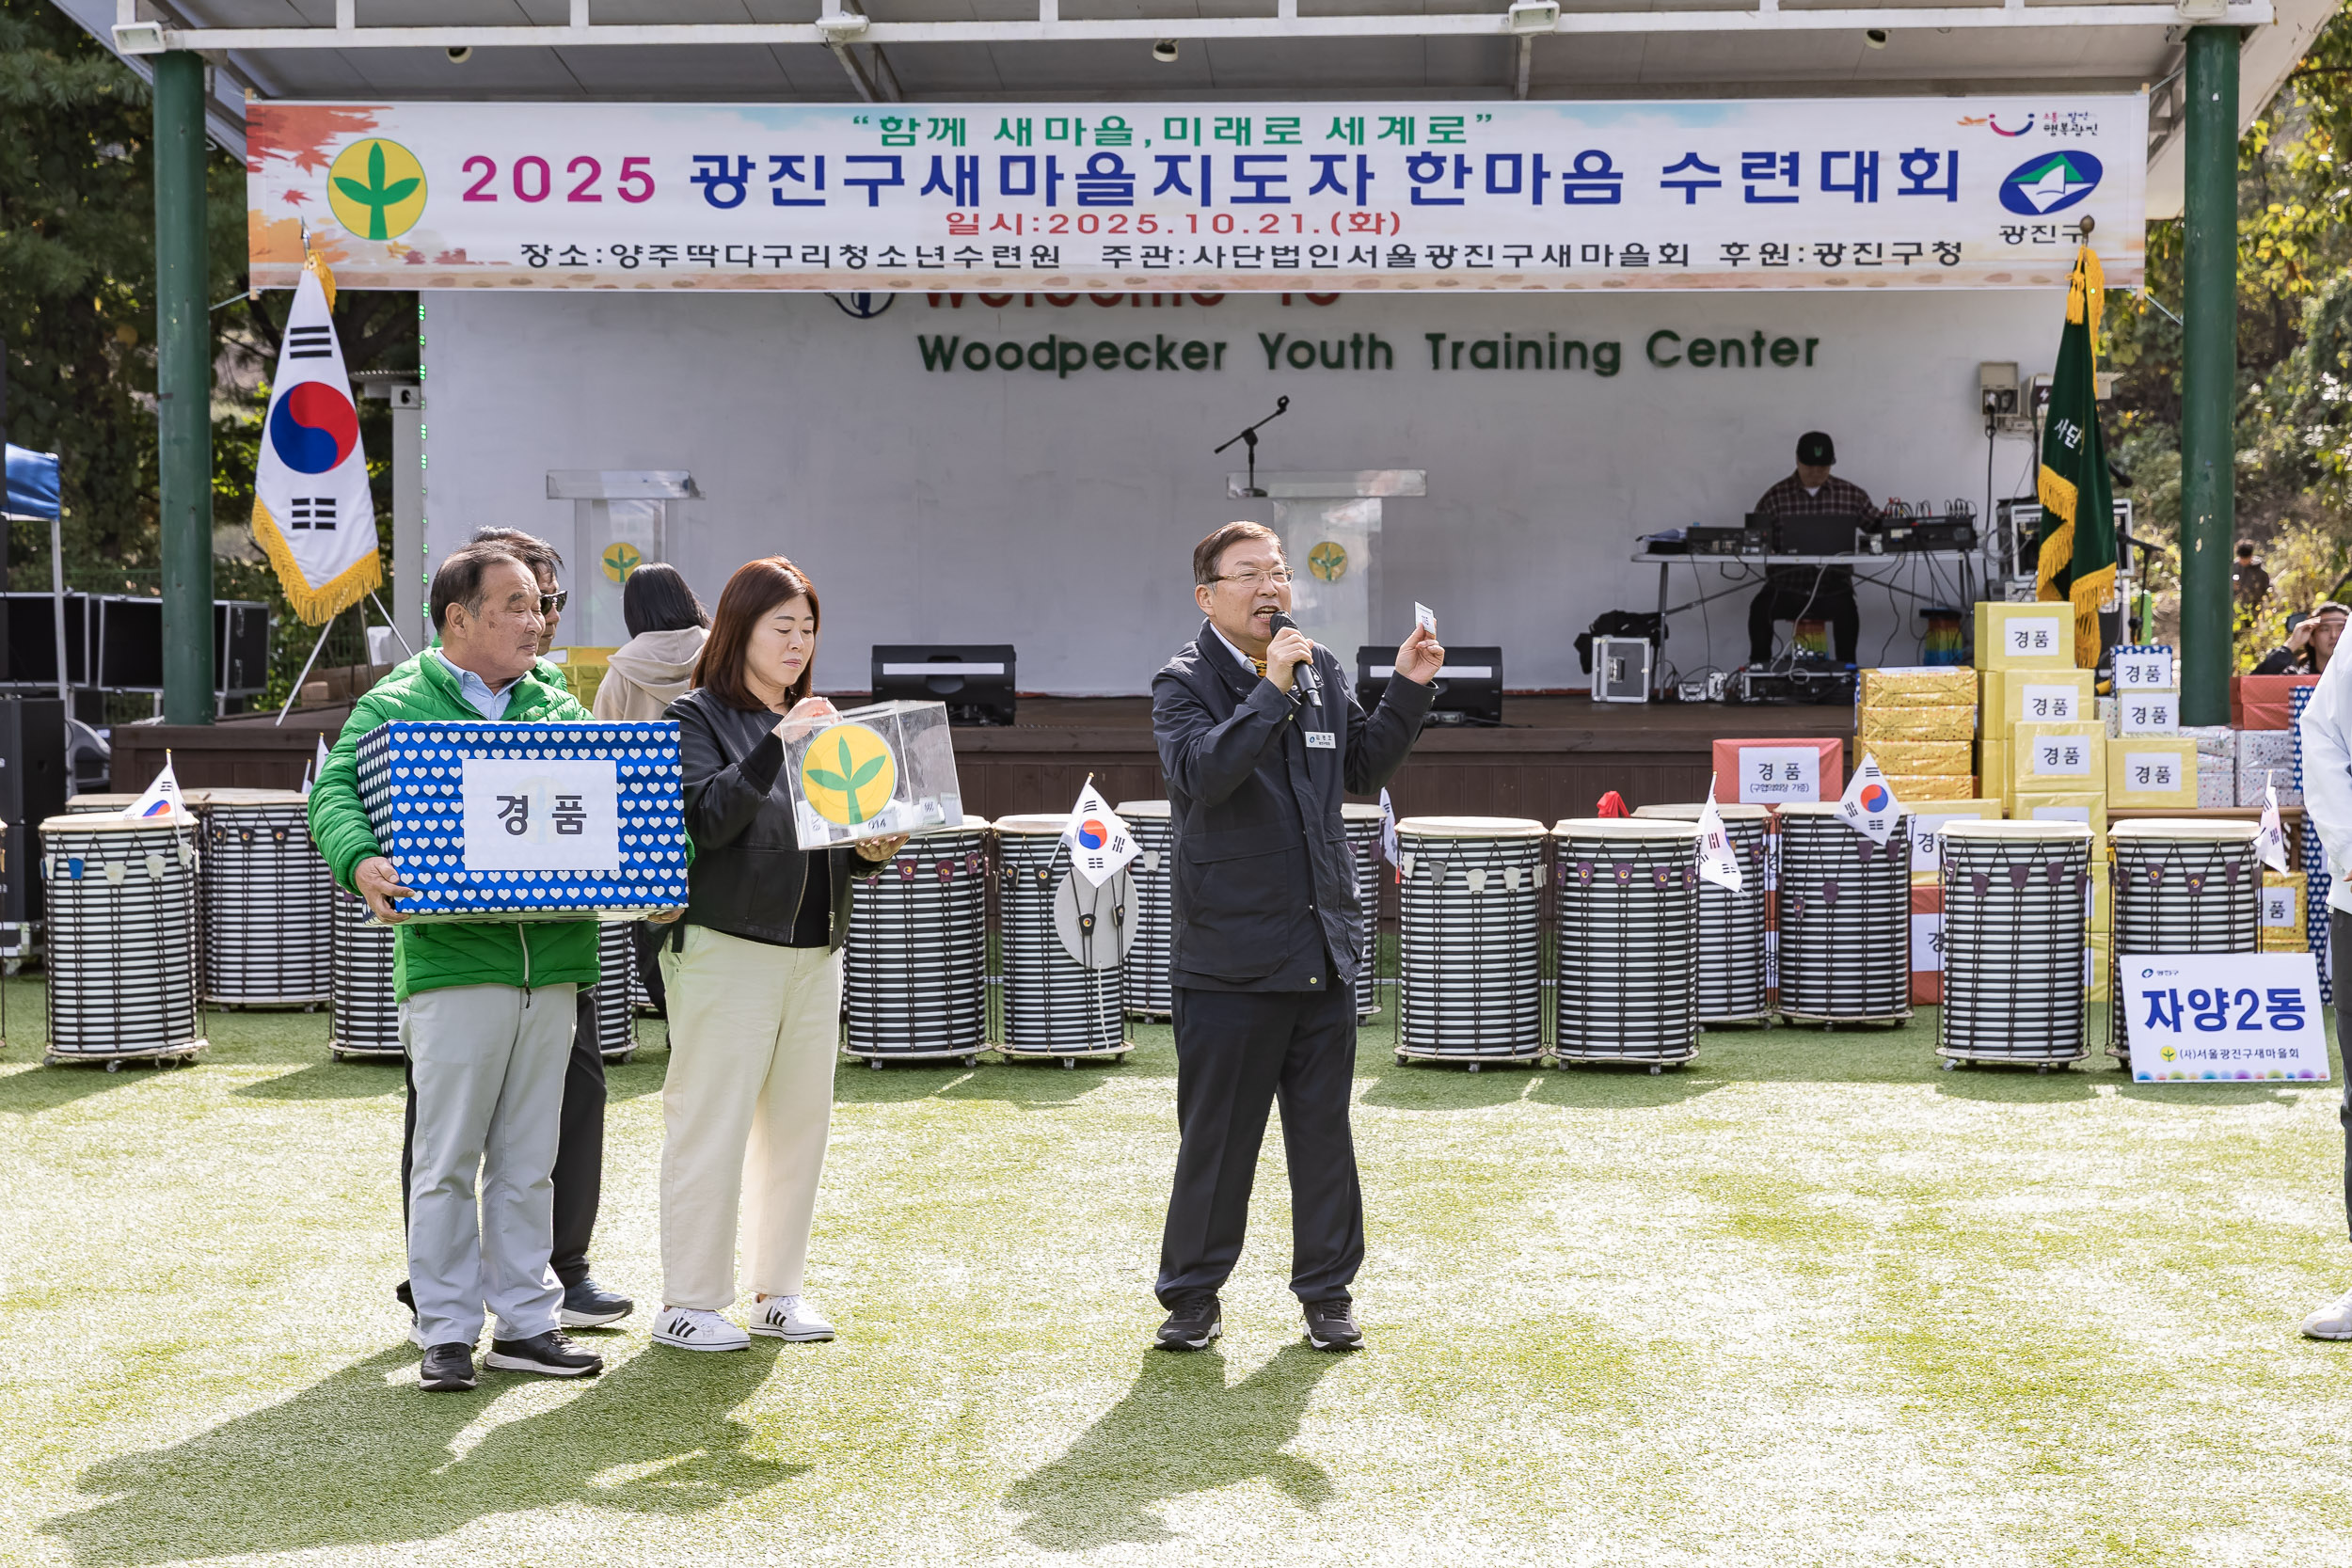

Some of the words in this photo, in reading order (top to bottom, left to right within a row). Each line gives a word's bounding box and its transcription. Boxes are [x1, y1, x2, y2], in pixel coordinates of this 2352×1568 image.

[463, 156, 655, 203] 2025
[691, 152, 1375, 208] 광진구새마을지도자
[1406, 150, 1623, 205] 한마음
[1661, 148, 1958, 204] 수련대회
[946, 212, 1400, 236] 일시:2025.10.21.(화)
[1103, 243, 1688, 269] 주관:사단법인서울광진구새마을회
[1720, 242, 1961, 267] 후원:광진구청
[917, 335, 1226, 378] Woodpecker
[1259, 333, 1392, 370] Youth
[1425, 332, 1620, 376] Training
[1646, 330, 1819, 368] Center
[2141, 988, 2306, 1033] 자양2동
